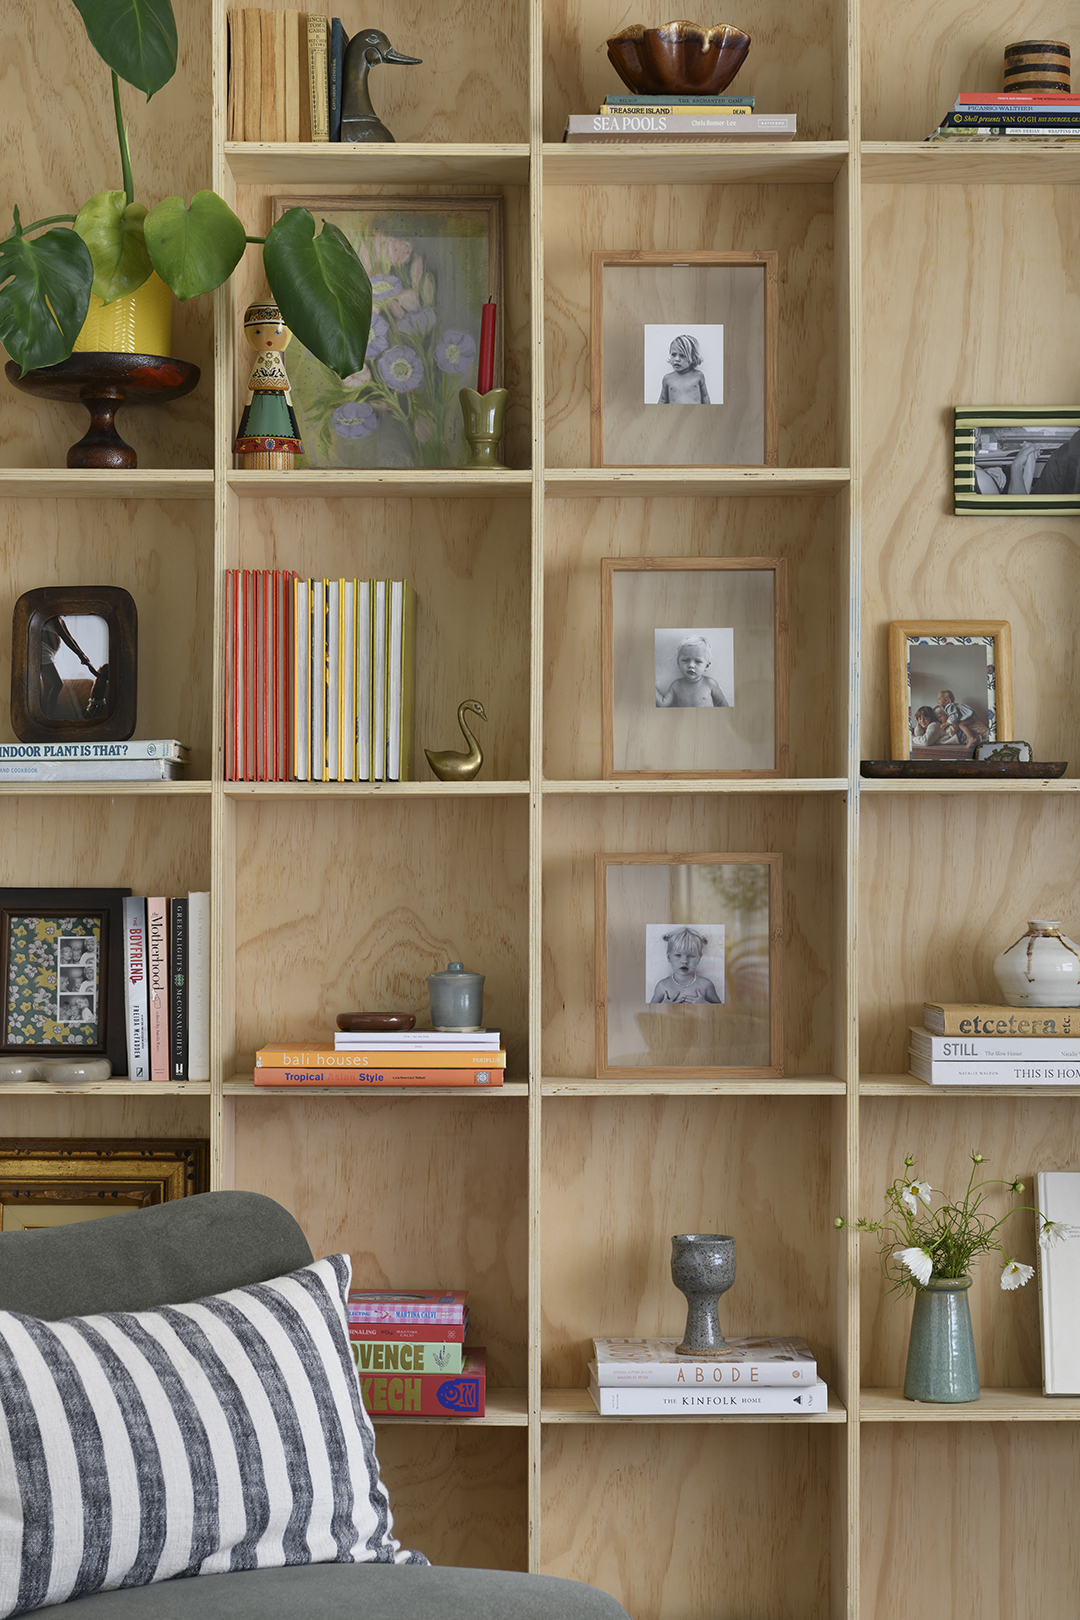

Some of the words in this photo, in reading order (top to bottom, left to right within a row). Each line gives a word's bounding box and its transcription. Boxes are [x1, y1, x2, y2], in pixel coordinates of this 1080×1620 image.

[593, 117, 620, 130] SEA
[622, 117, 667, 130] POOLS
[44, 746, 79, 757] PLANT
[80, 745, 91, 756] IS
[93, 745, 128, 756] THAT?
[130, 928, 143, 981] BOYFRIEND
[151, 916, 165, 989] Motherhood
[959, 1015, 1057, 1034] etcetera
[1062, 1015, 1071, 1034] etc.
[943, 1043, 978, 1056] STILL
[283, 1053, 309, 1065] bali
[317, 1053, 368, 1065] houses
[285, 1073, 324, 1082] Tropical
[327, 1073, 356, 1081] Asian
[359, 1073, 384, 1082] Style
[1014, 1069, 1041, 1078] THIS
[1044, 1069, 1054, 1078] IS
[677, 1367, 758, 1382] ABODE
[360, 1377, 421, 1411] KECH
[682, 1396, 737, 1405] KINFOLK
